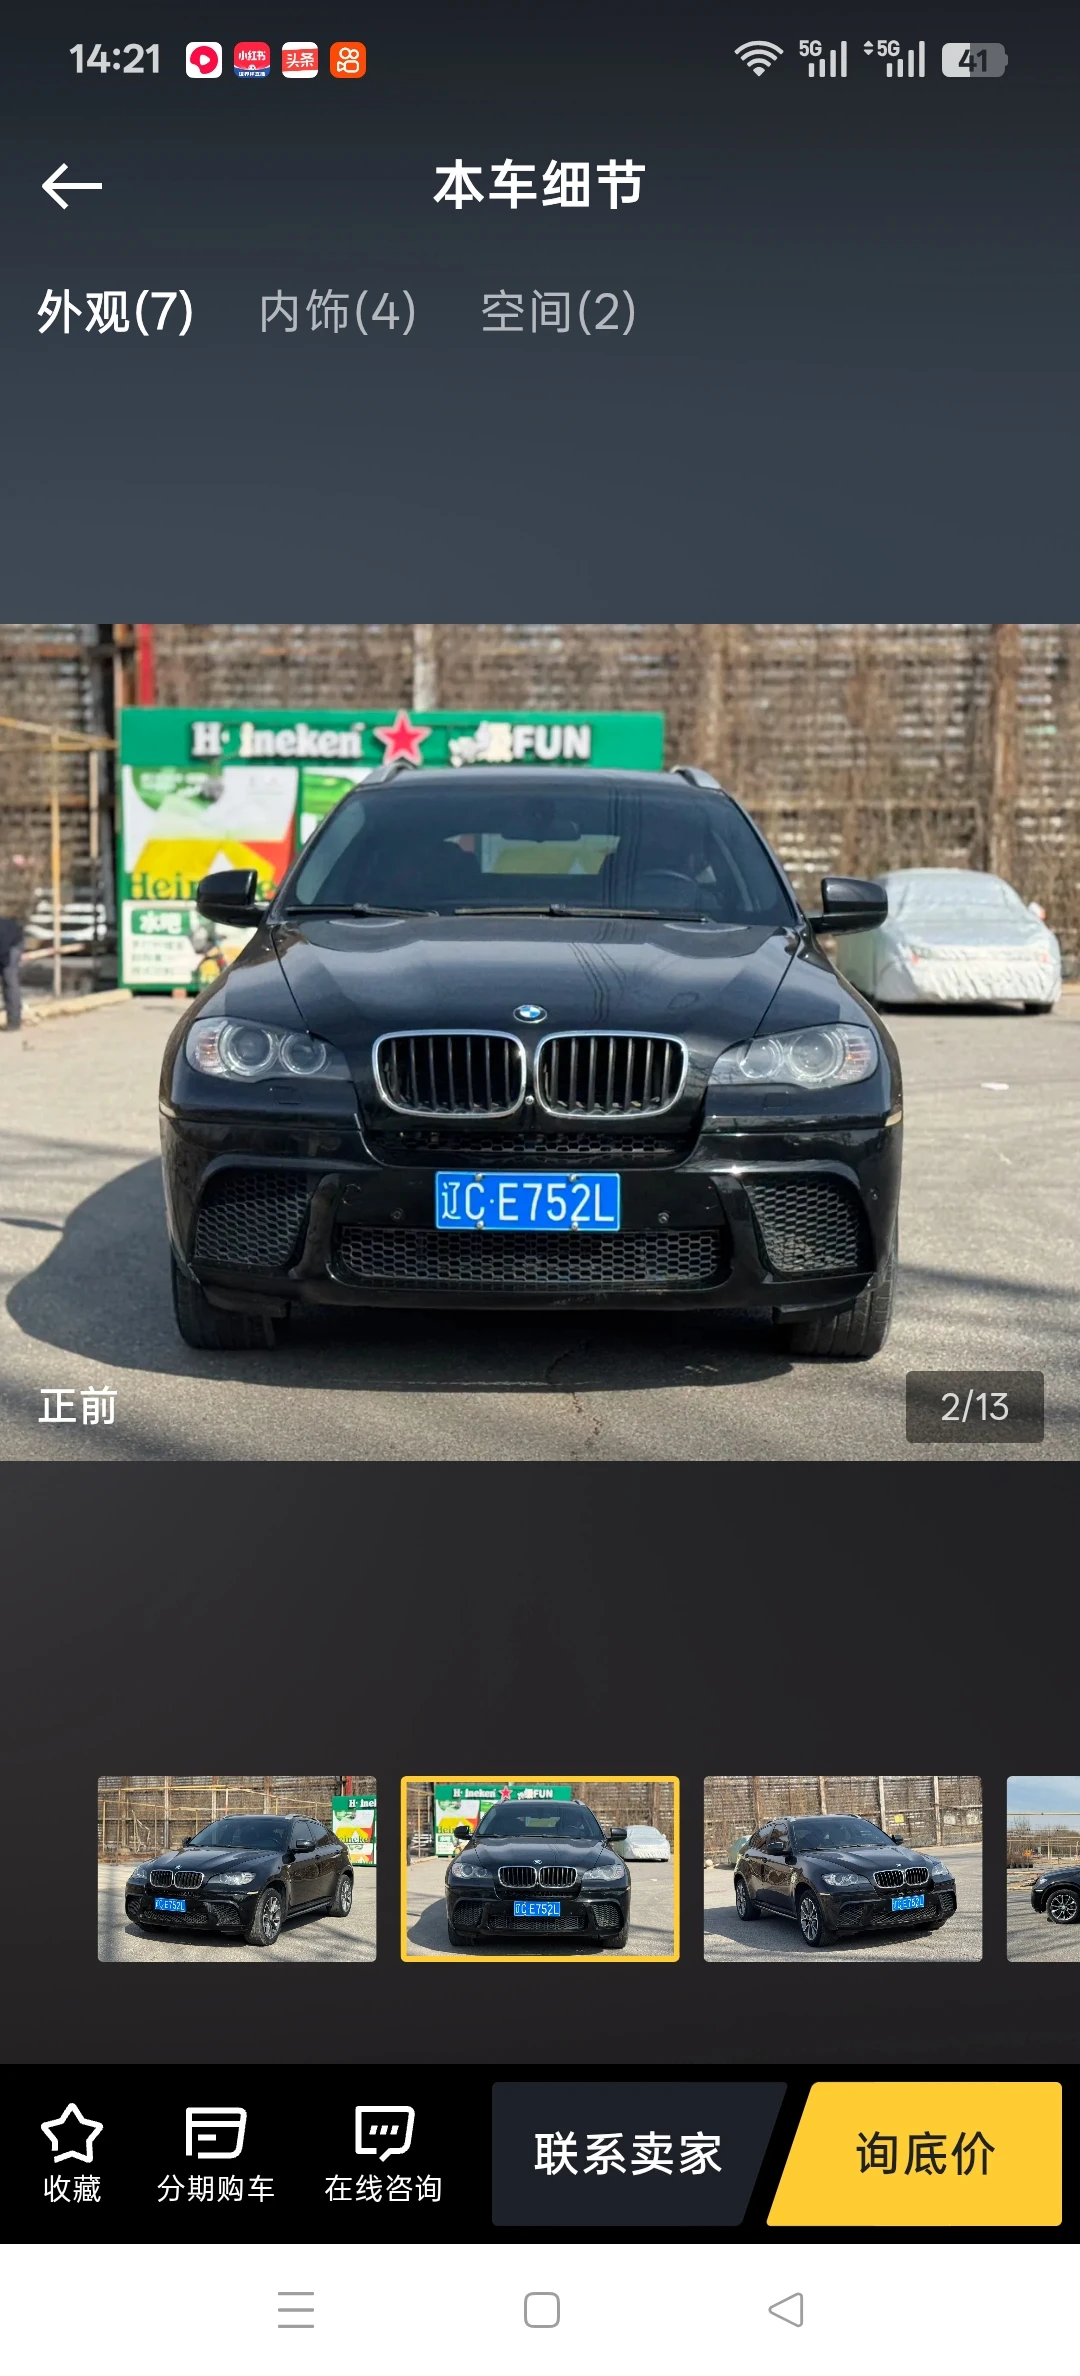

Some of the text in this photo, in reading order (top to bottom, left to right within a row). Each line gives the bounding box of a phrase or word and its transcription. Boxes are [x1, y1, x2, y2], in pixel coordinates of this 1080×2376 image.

[69, 42, 160, 74] 14:21
[238, 50, 267, 61] 小红书
[285, 52, 315, 69] 头条
[799, 39, 823, 57] 5G
[877, 39, 901, 57] 5G
[958, 49, 988, 73] 41
[432, 157, 646, 210] 本车细节
[36, 288, 194, 337] 外观(7)
[261, 288, 416, 337] 内饰(4)
[481, 288, 636, 337] 空间(2)
[192, 721, 365, 758] Hineken
[441, 1181, 615, 1222] 辽C·E752L
[533, 2130, 723, 2176] 联系卖家
[856, 2130, 996, 2176] 询底价
[43, 2173, 102, 2204] 收藏
[156, 2173, 275, 2204] 分期购车
[324, 2173, 443, 2204] 在线咨询
